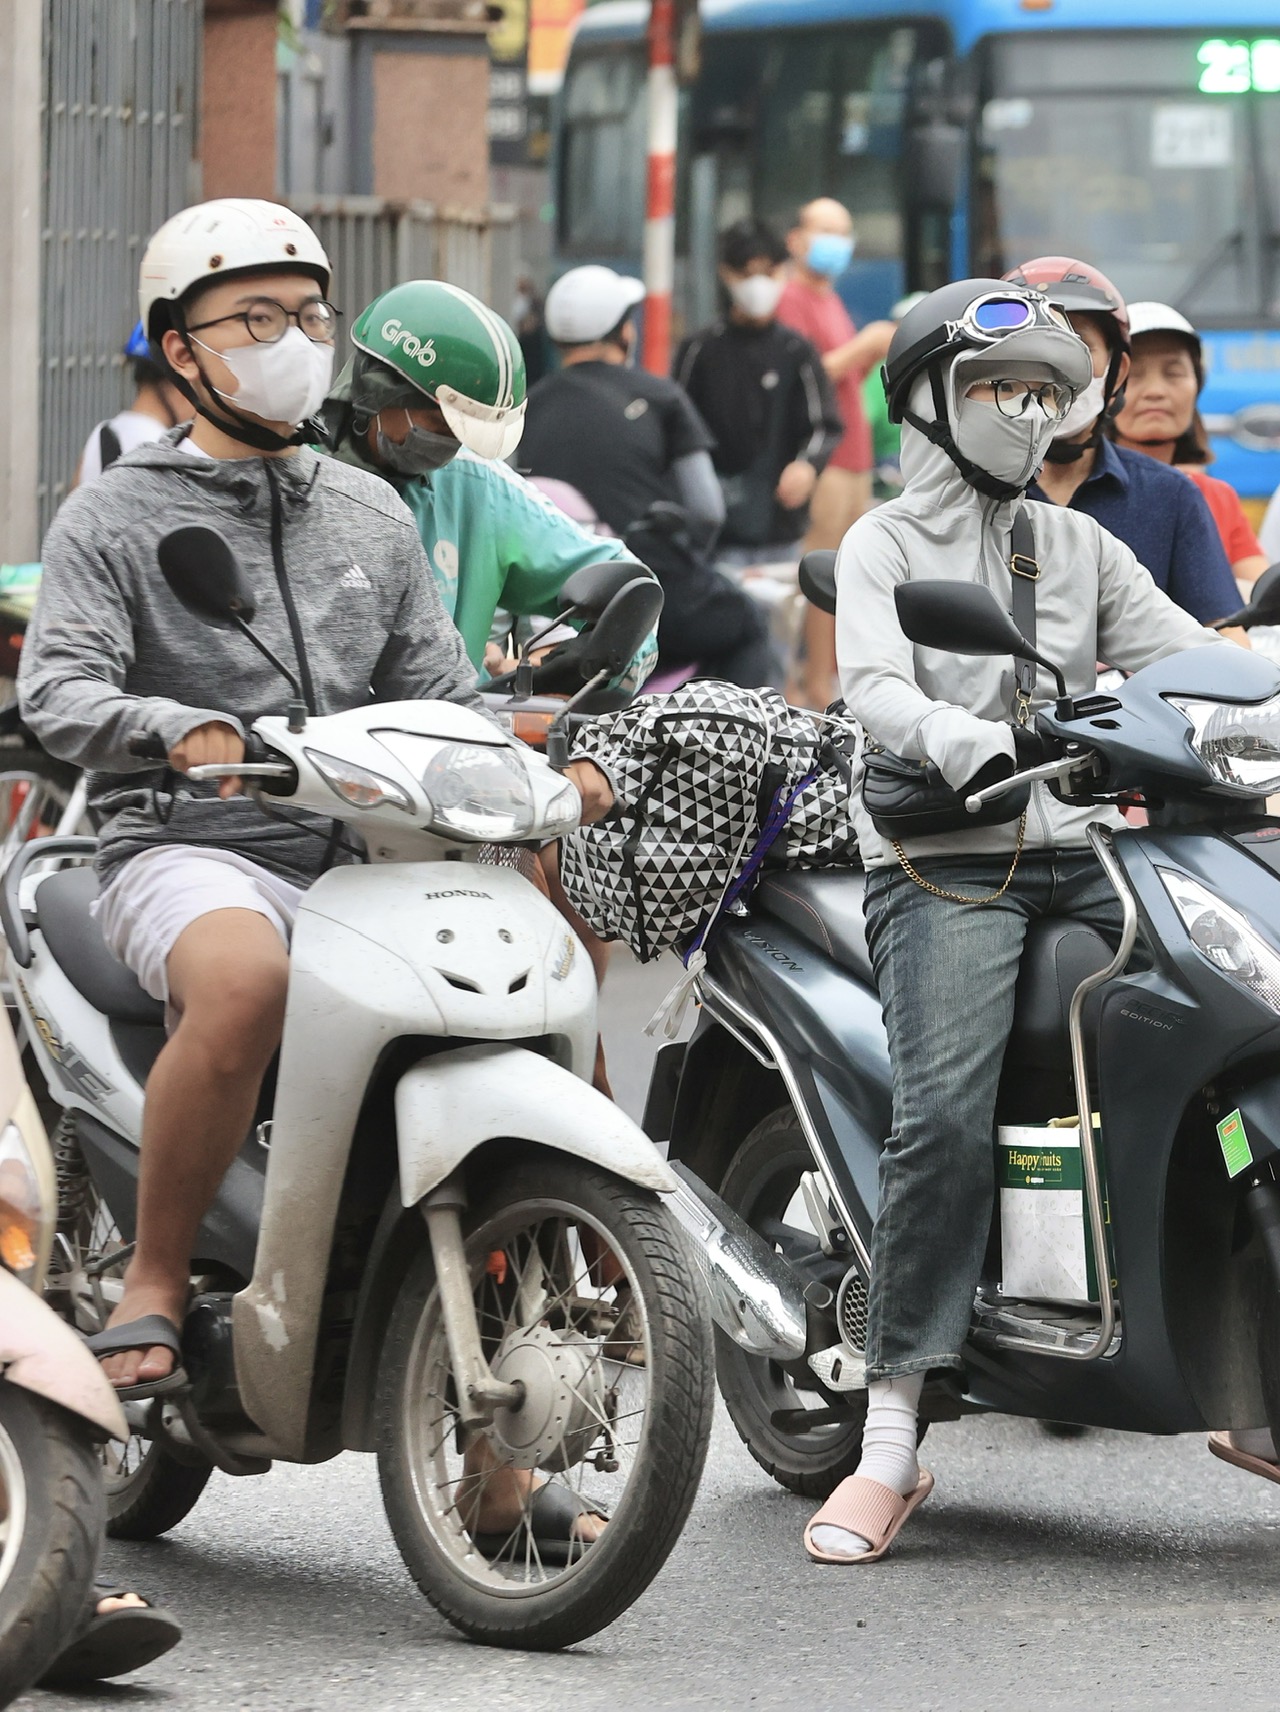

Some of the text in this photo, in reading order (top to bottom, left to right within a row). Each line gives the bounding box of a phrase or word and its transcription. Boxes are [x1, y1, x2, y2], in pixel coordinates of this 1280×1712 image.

[381, 318, 437, 367] Grab
[424, 889, 495, 901] HONDA
[743, 930, 805, 973] VISION
[1120, 1008, 1174, 1031] EDITION
